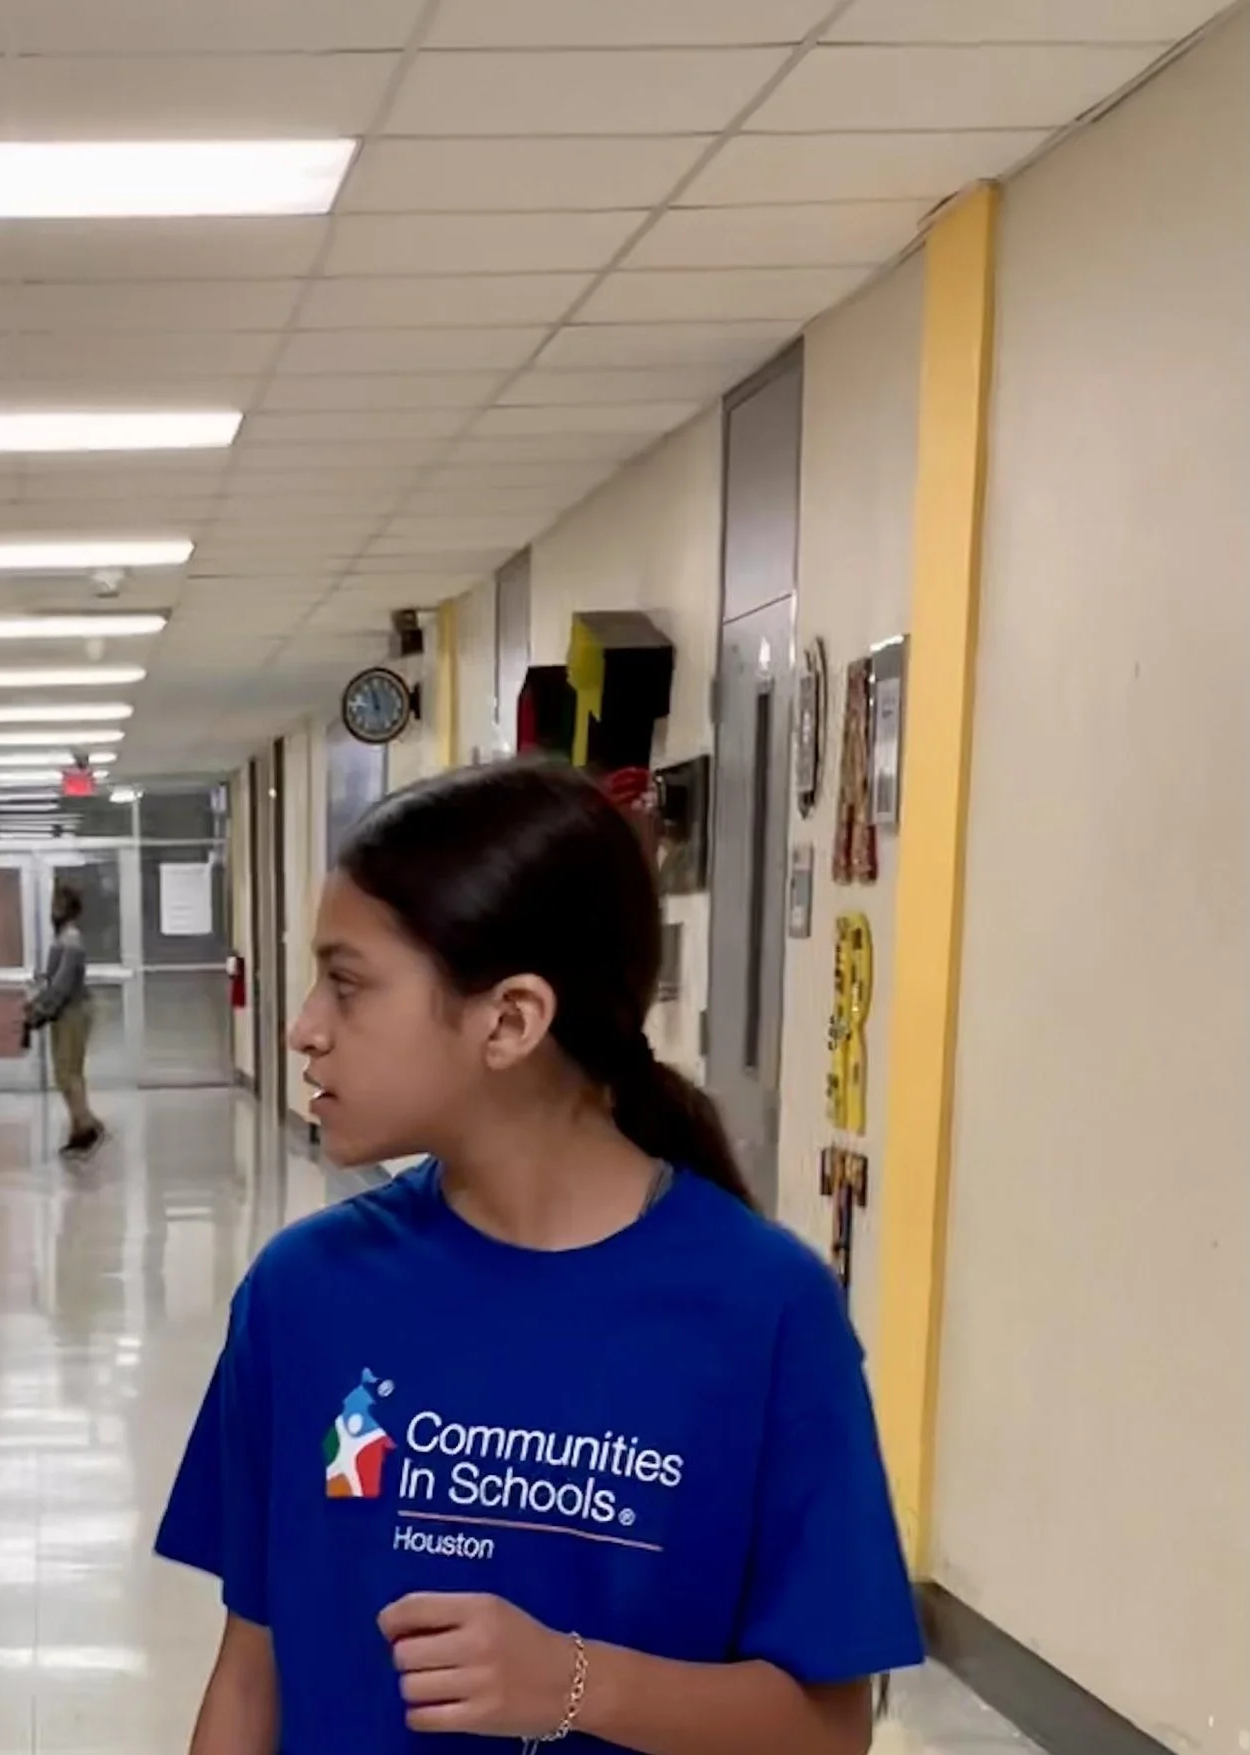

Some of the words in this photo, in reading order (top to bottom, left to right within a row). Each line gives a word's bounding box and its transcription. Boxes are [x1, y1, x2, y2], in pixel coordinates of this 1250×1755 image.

[407, 1411, 683, 1486] Communities
[400, 1459, 435, 1499] In
[394, 1527, 494, 1558] Houston
